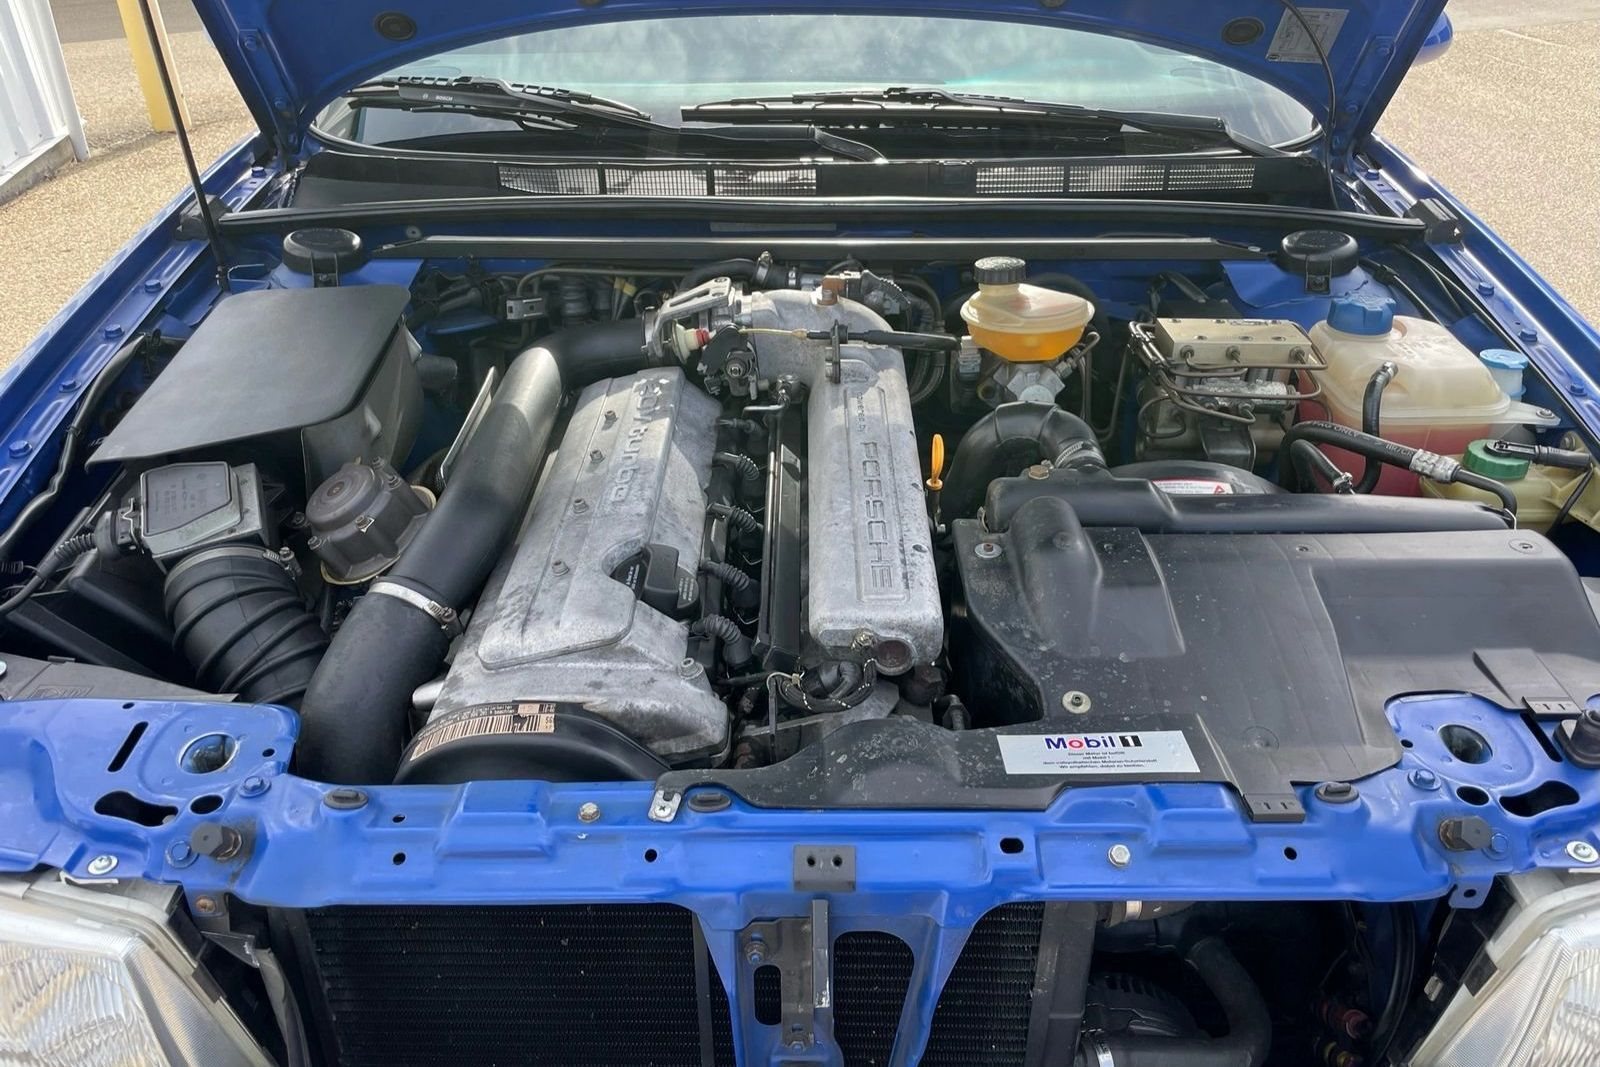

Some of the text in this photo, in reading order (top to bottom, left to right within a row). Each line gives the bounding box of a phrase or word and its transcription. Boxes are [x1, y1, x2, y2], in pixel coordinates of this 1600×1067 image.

[1333, 426, 1359, 438] ONLY
[861, 441, 893, 589] PORSCHE
[1044, 735, 1116, 750] Mobil
